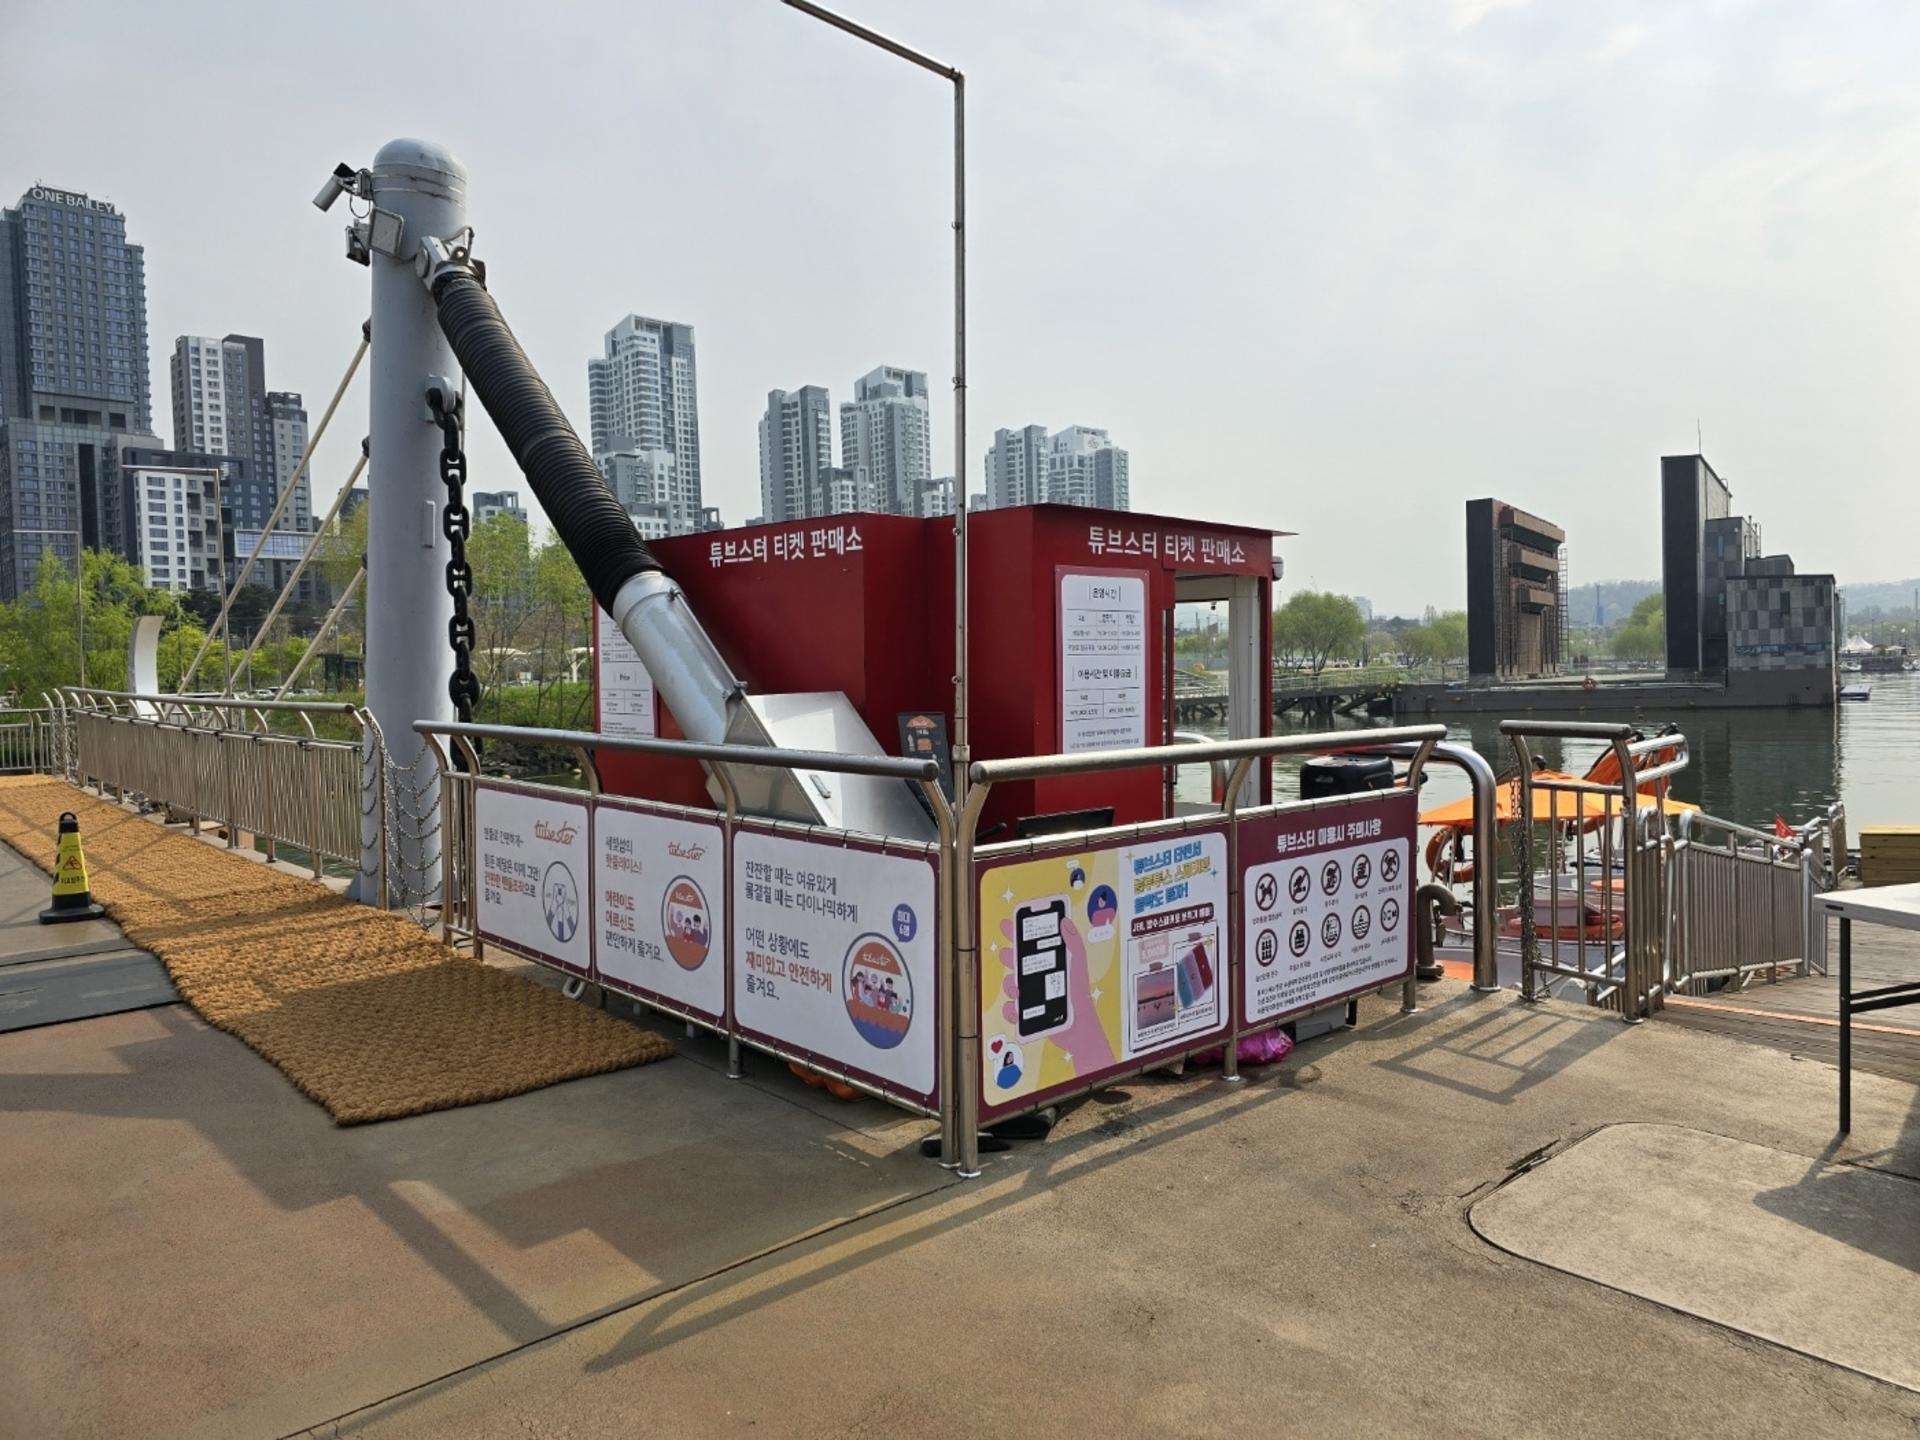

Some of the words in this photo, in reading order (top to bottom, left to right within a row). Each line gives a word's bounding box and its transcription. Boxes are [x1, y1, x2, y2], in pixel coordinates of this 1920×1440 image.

[32, 188, 64, 204] ONE
[66, 195, 115, 214] BAILEY
[709, 535, 768, 568] 튜브스터
[773, 530, 805, 561] 티켓
[810, 525, 863, 558] 판매소
[1088, 526, 1158, 559] 튜브스터
[1164, 534, 1196, 563] 티켓
[1200, 537, 1246, 566] 판매소
[1092, 587, 1118, 600] 운영시간
[605, 836, 633, 855] 세빛섬의
[1277, 828, 1315, 853] 튜브스터
[1318, 823, 1346, 845] 이용시
[1346, 817, 1383, 841] 주의사항
[605, 853, 643, 874] 핫플레이스!
[1134, 849, 1172, 875] 튜브스터
[745, 860, 773, 883] 잔잔할
[774, 866, 794, 887] 때는
[795, 871, 837, 896] 여유있게
[605, 889, 635, 911] 어린이도
[744, 882, 773, 905] 물결칠
[774, 888, 794, 908] 때는
[796, 893, 858, 924] 다이나믹하게
[605, 910, 635, 932] 어르신도
[605, 930, 636, 954] 편안하게
[745, 926, 766, 947] 어떤
[767, 932, 810, 960] 상황에도
[745, 951, 787, 979] 재미있고
[788, 963, 833, 994] 안전하게
[745, 976, 781, 1001] 즐겨요.
